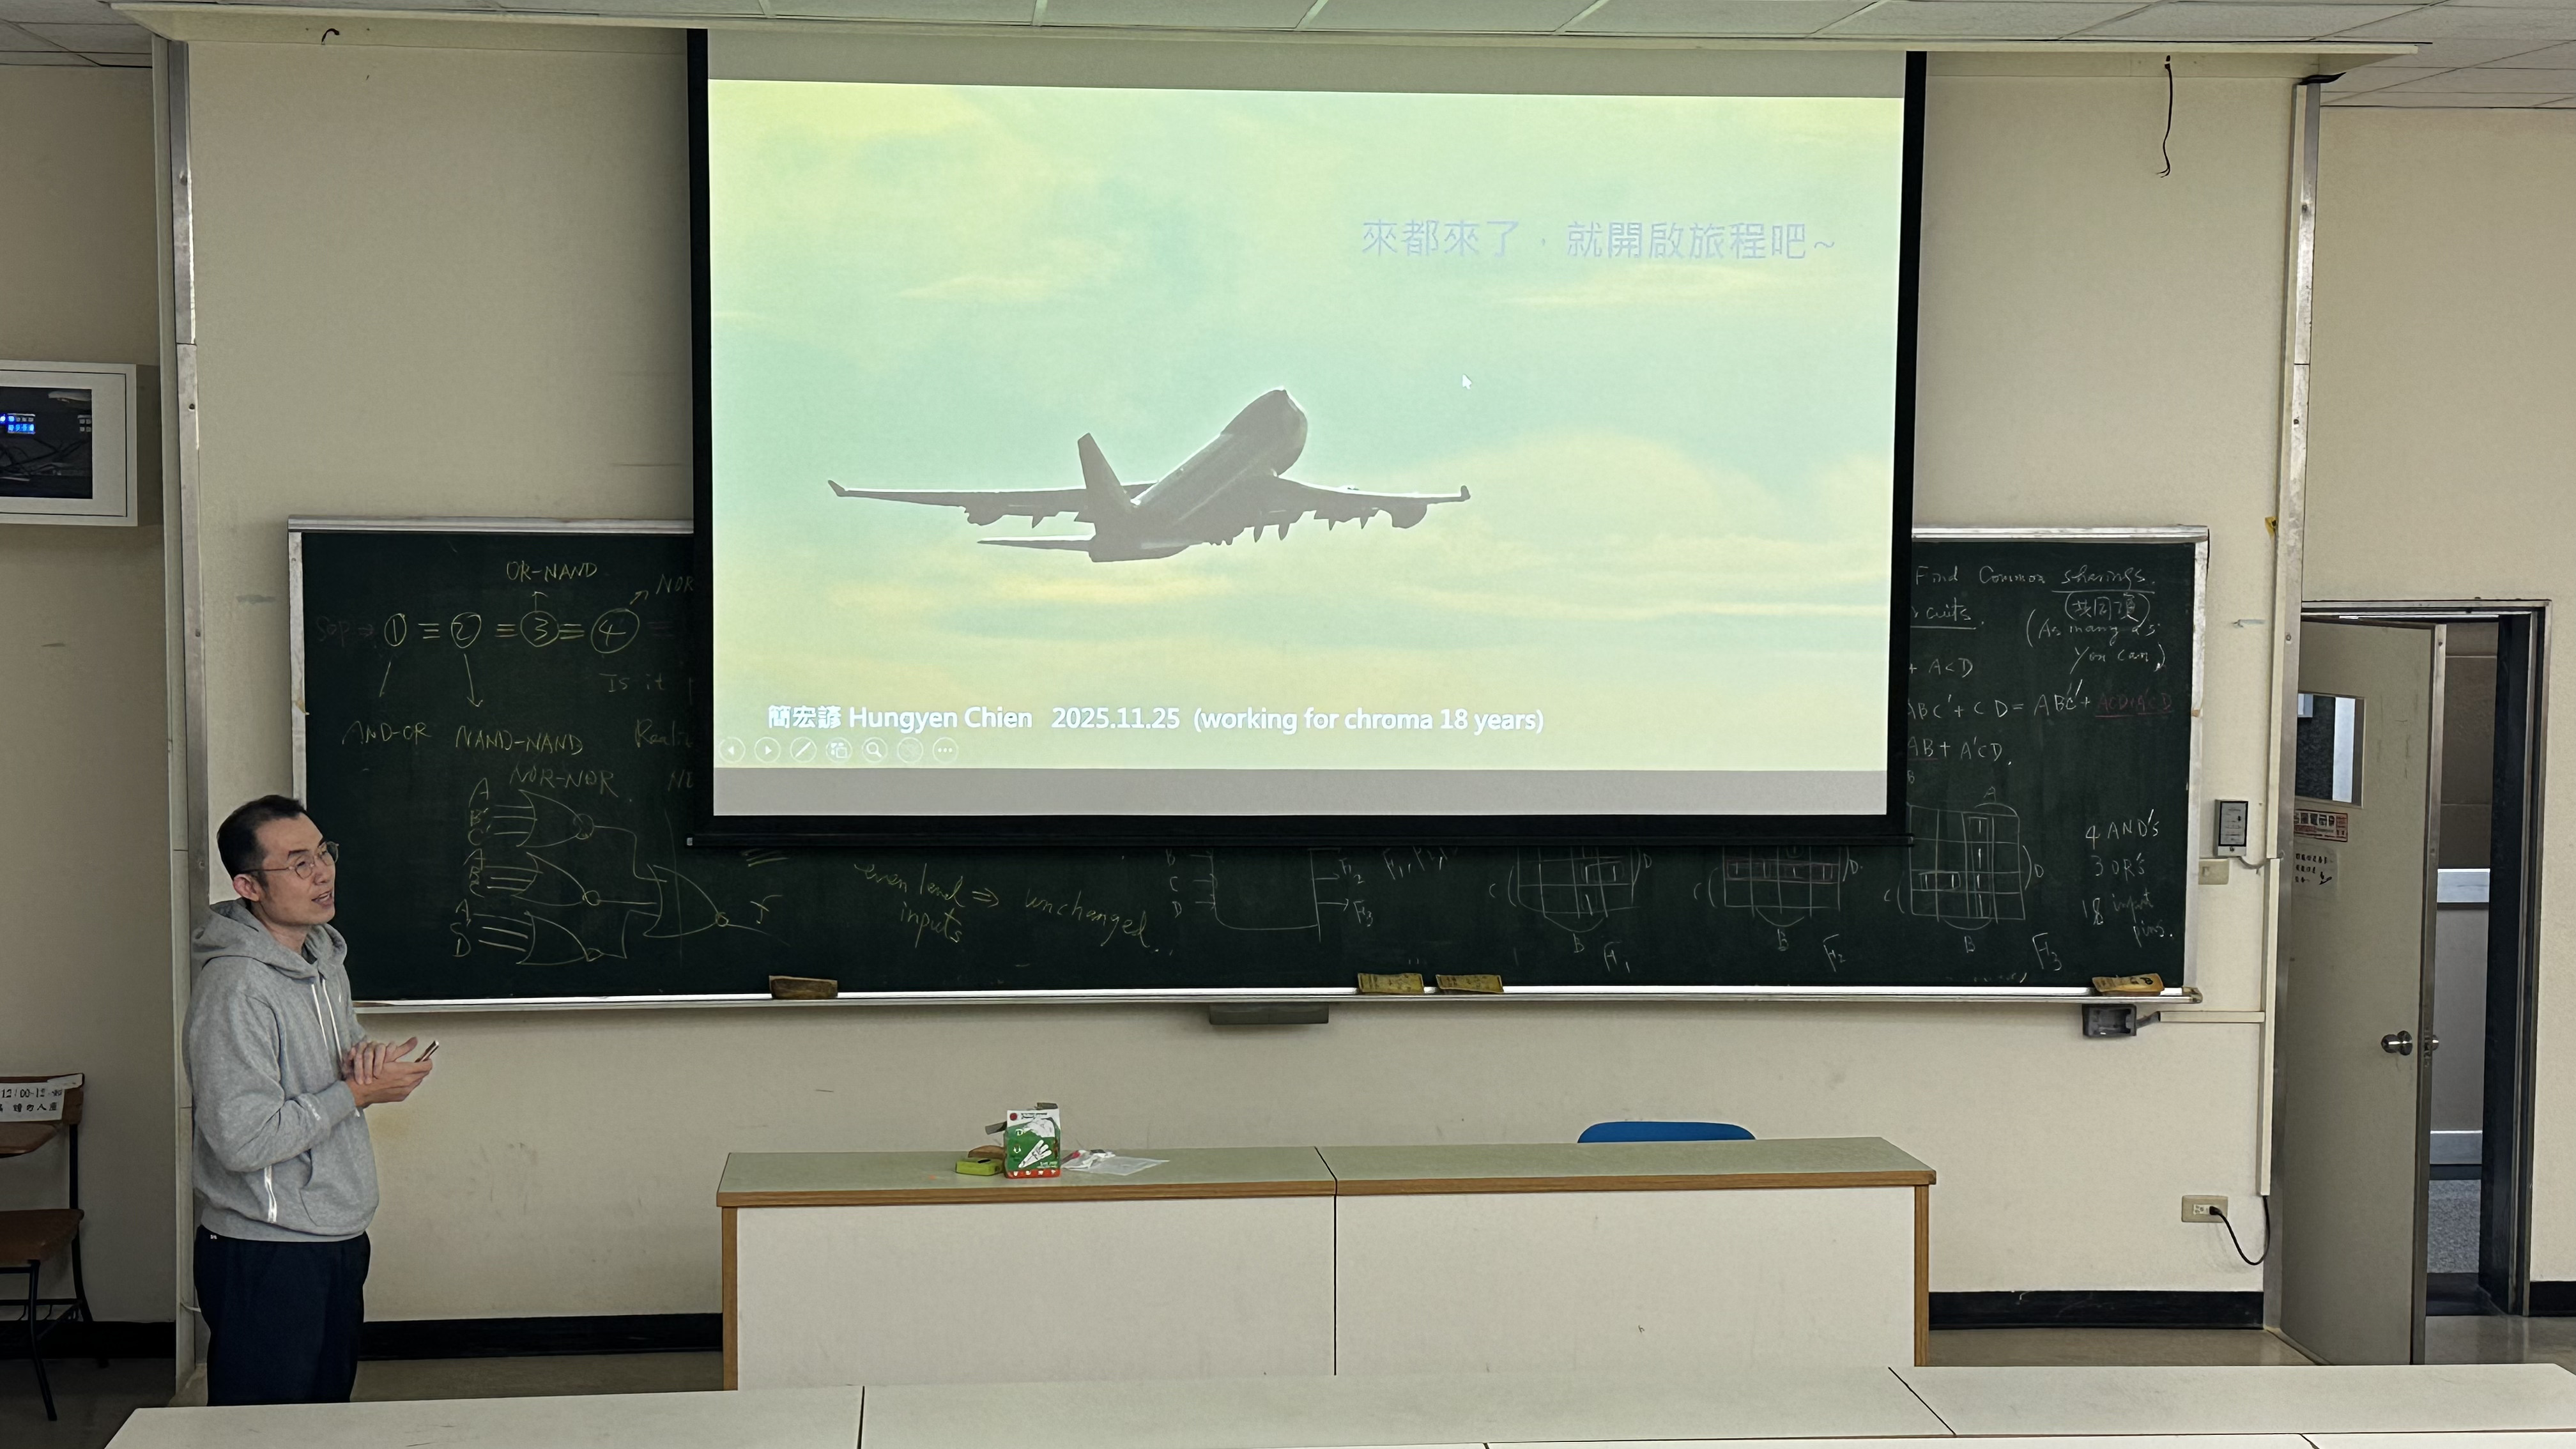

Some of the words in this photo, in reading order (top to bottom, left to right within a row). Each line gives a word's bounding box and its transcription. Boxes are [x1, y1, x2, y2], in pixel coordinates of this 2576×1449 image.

[507, 561, 597, 580] OR-NAND
[1915, 565, 1959, 585] Find
[1979, 565, 2046, 585] Common
[2069, 624, 2120, 647] many
[342, 720, 432, 745] AND-OR
[768, 705, 842, 730] 簡宏諺
[849, 706, 958, 733] Hungyen
[964, 706, 1032, 730] Chien
[1052, 707, 1181, 730] 2025.11.25
[1193, 707, 1298, 735] (working
[1304, 707, 1340, 730] for
[1344, 708, 1434, 730] chroma
[1440, 709, 1468, 730] 18
[1473, 709, 1544, 735] years)
[455, 724, 583, 755] NAND-NAND
[510, 765, 618, 799] NOR-NOR
